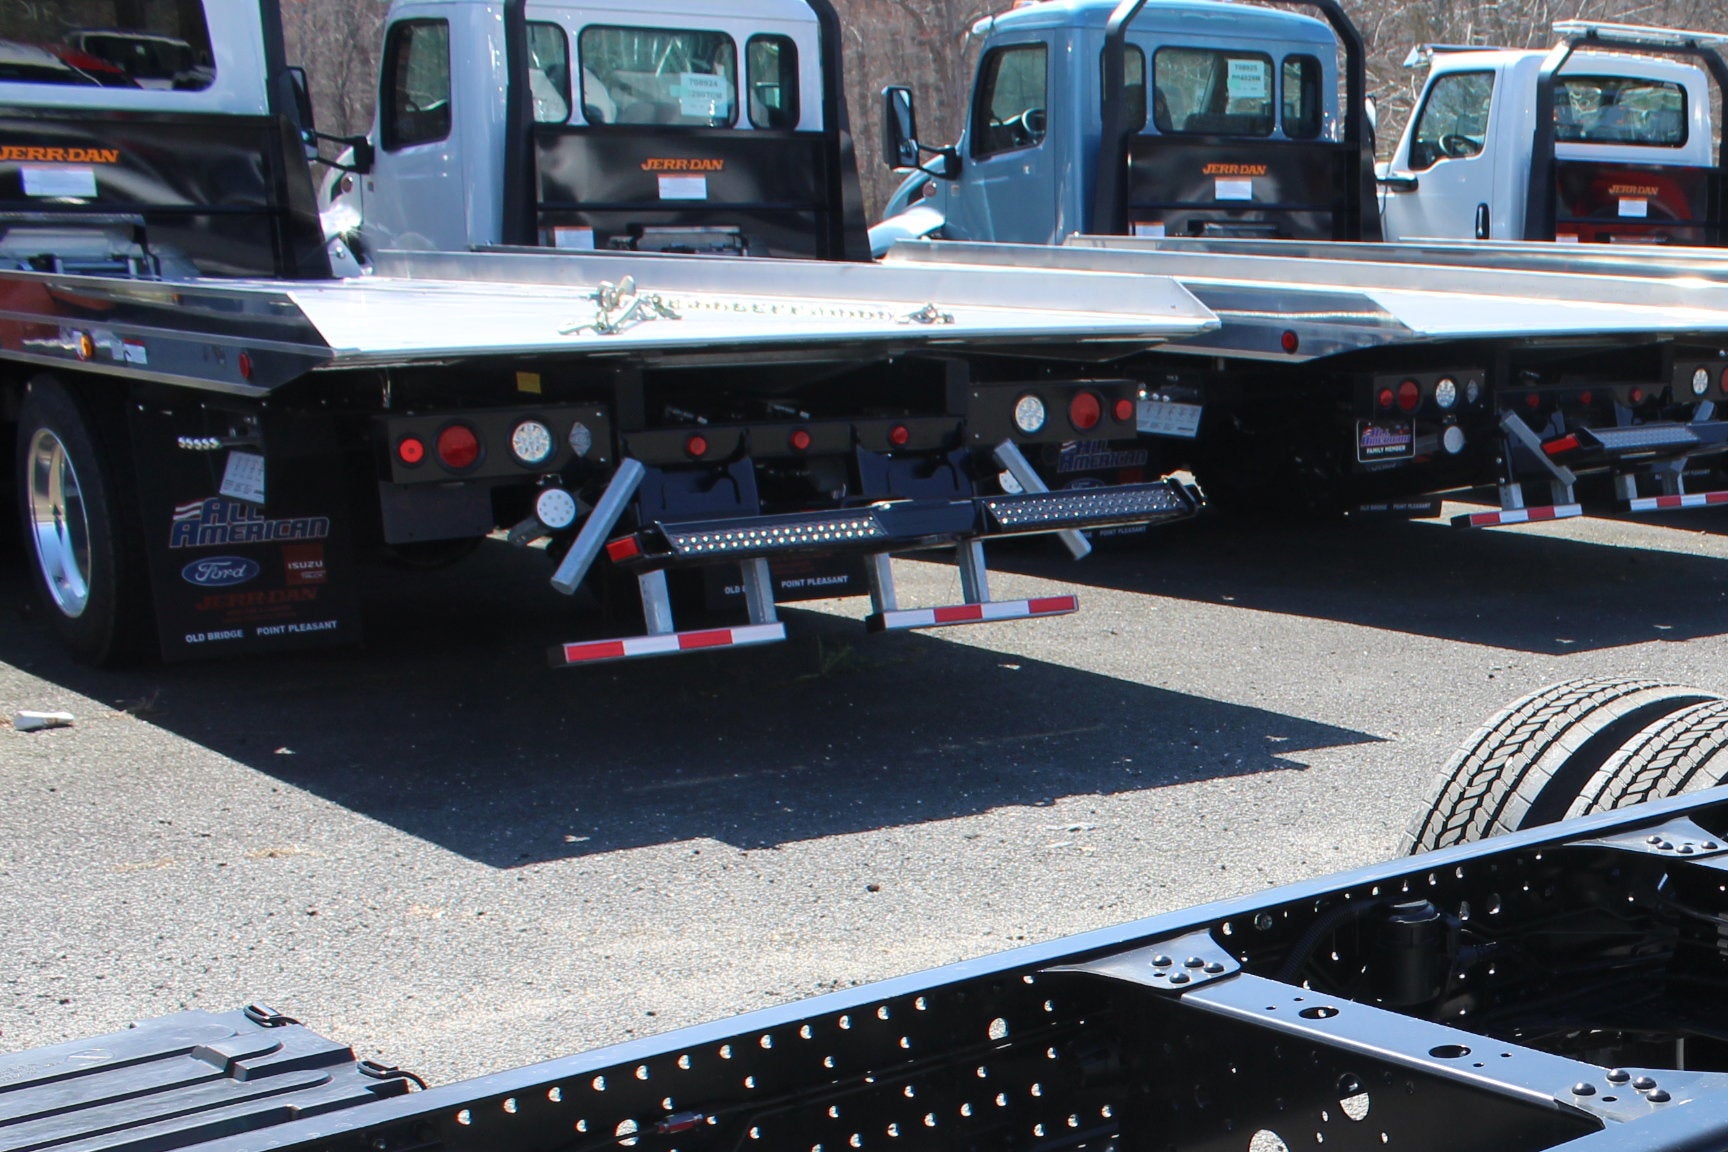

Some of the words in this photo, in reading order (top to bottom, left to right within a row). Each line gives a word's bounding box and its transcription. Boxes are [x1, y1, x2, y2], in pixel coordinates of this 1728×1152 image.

[201, 497, 264, 525] ALL
[169, 516, 331, 549] AMERICAN
[193, 560, 248, 582] Ford
[288, 560, 323, 570] ISUZU
[724, 585, 741, 595] OLD
[781, 579, 805, 588] POINT
[806, 575, 849, 586] PLEASANT
[185, 633, 206, 643] OLD
[207, 629, 245, 641] BRIDGE
[256, 625, 286, 636] POINT
[288, 620, 338, 632] PLEASANT
